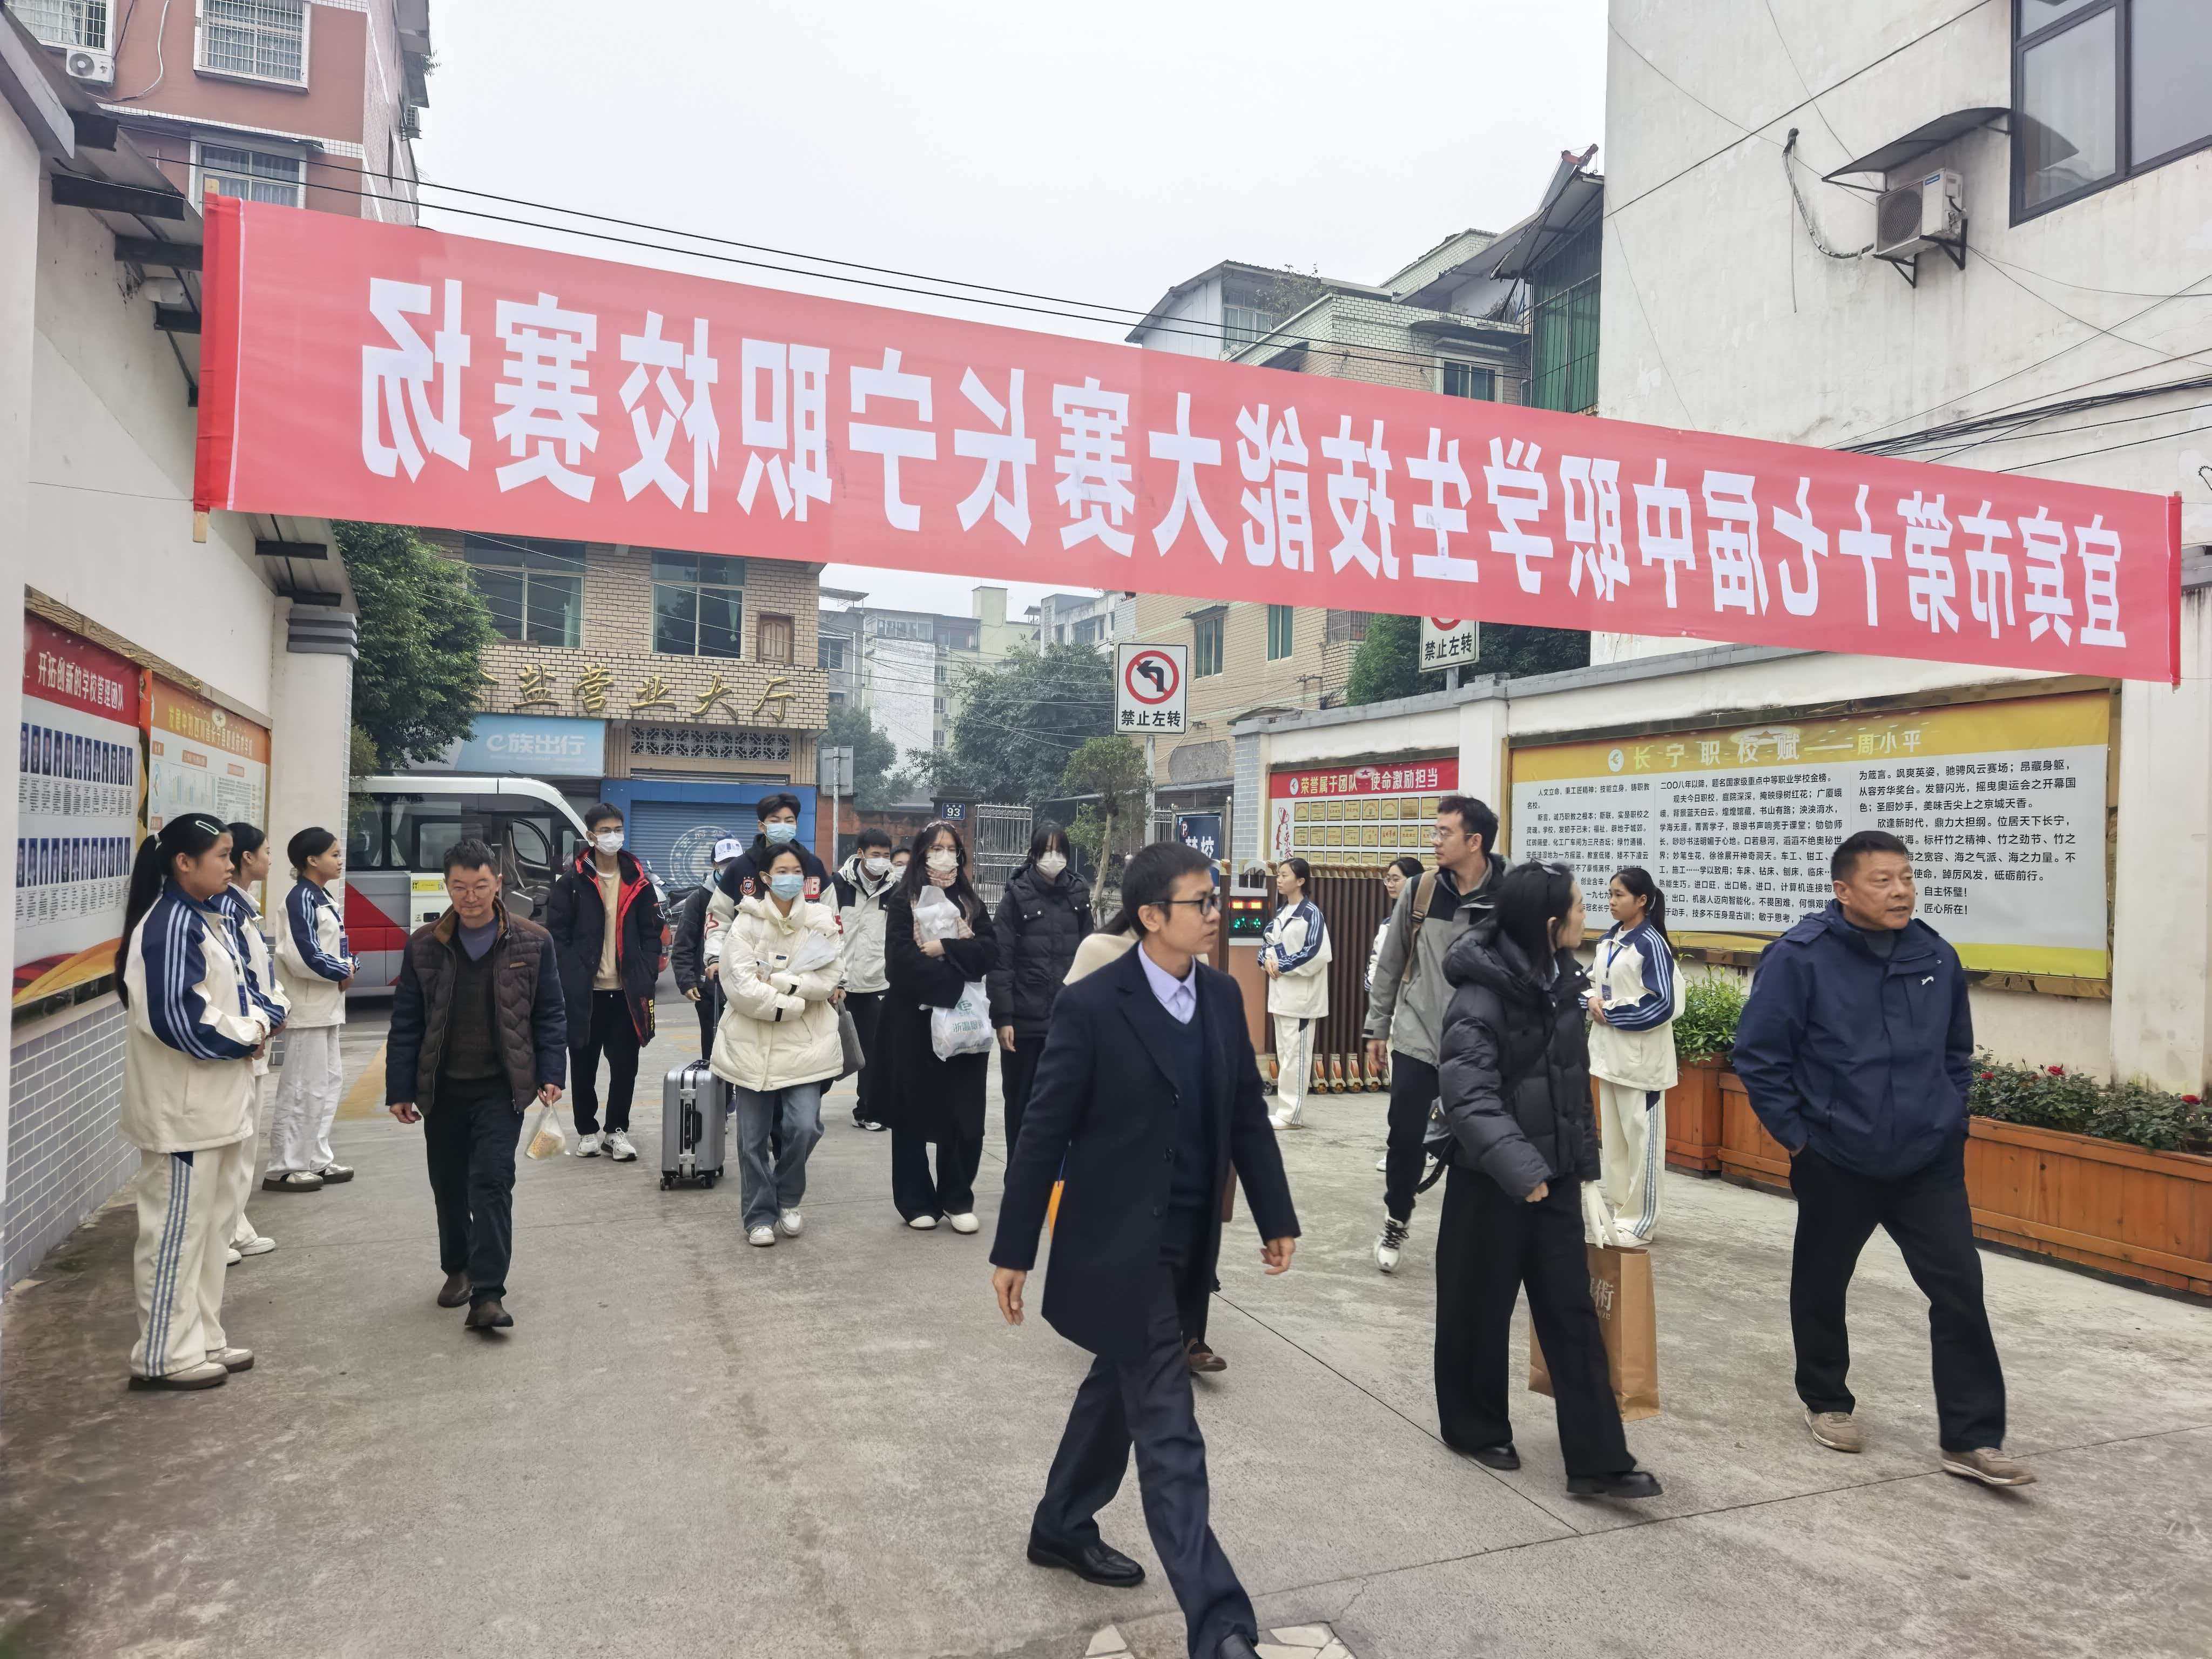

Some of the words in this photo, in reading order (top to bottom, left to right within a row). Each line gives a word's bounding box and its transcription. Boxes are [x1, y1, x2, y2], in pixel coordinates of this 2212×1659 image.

[1425, 633, 1473, 660] 禁止左转
[38, 651, 124, 711] 开拓创新的学校管理团队
[1121, 710, 1181, 727] 禁止左转
[1859, 759, 2070, 780] 为箴言。飒爽英姿，驰骋风云赛场；昂藏身躯，
[1301, 774, 1358, 794] 荣誉属于团队
[1370, 767, 1438, 791] 使命激励担当
[1859, 777, 2076, 796] 从容芳华奖台。发簪闪光，摇曳奥运会之开幕国
[947, 807, 960, 817] 93
[1859, 798, 2034, 812] 色；圣厨妙手，美味舌尖上之京城天香。
[1878, 815, 2069, 828] 欣逢新时代，鼎力大担纲。位居天下长宁，
[1914, 869, 2044, 881] 使命，踔厉风发，砥砺前行。
